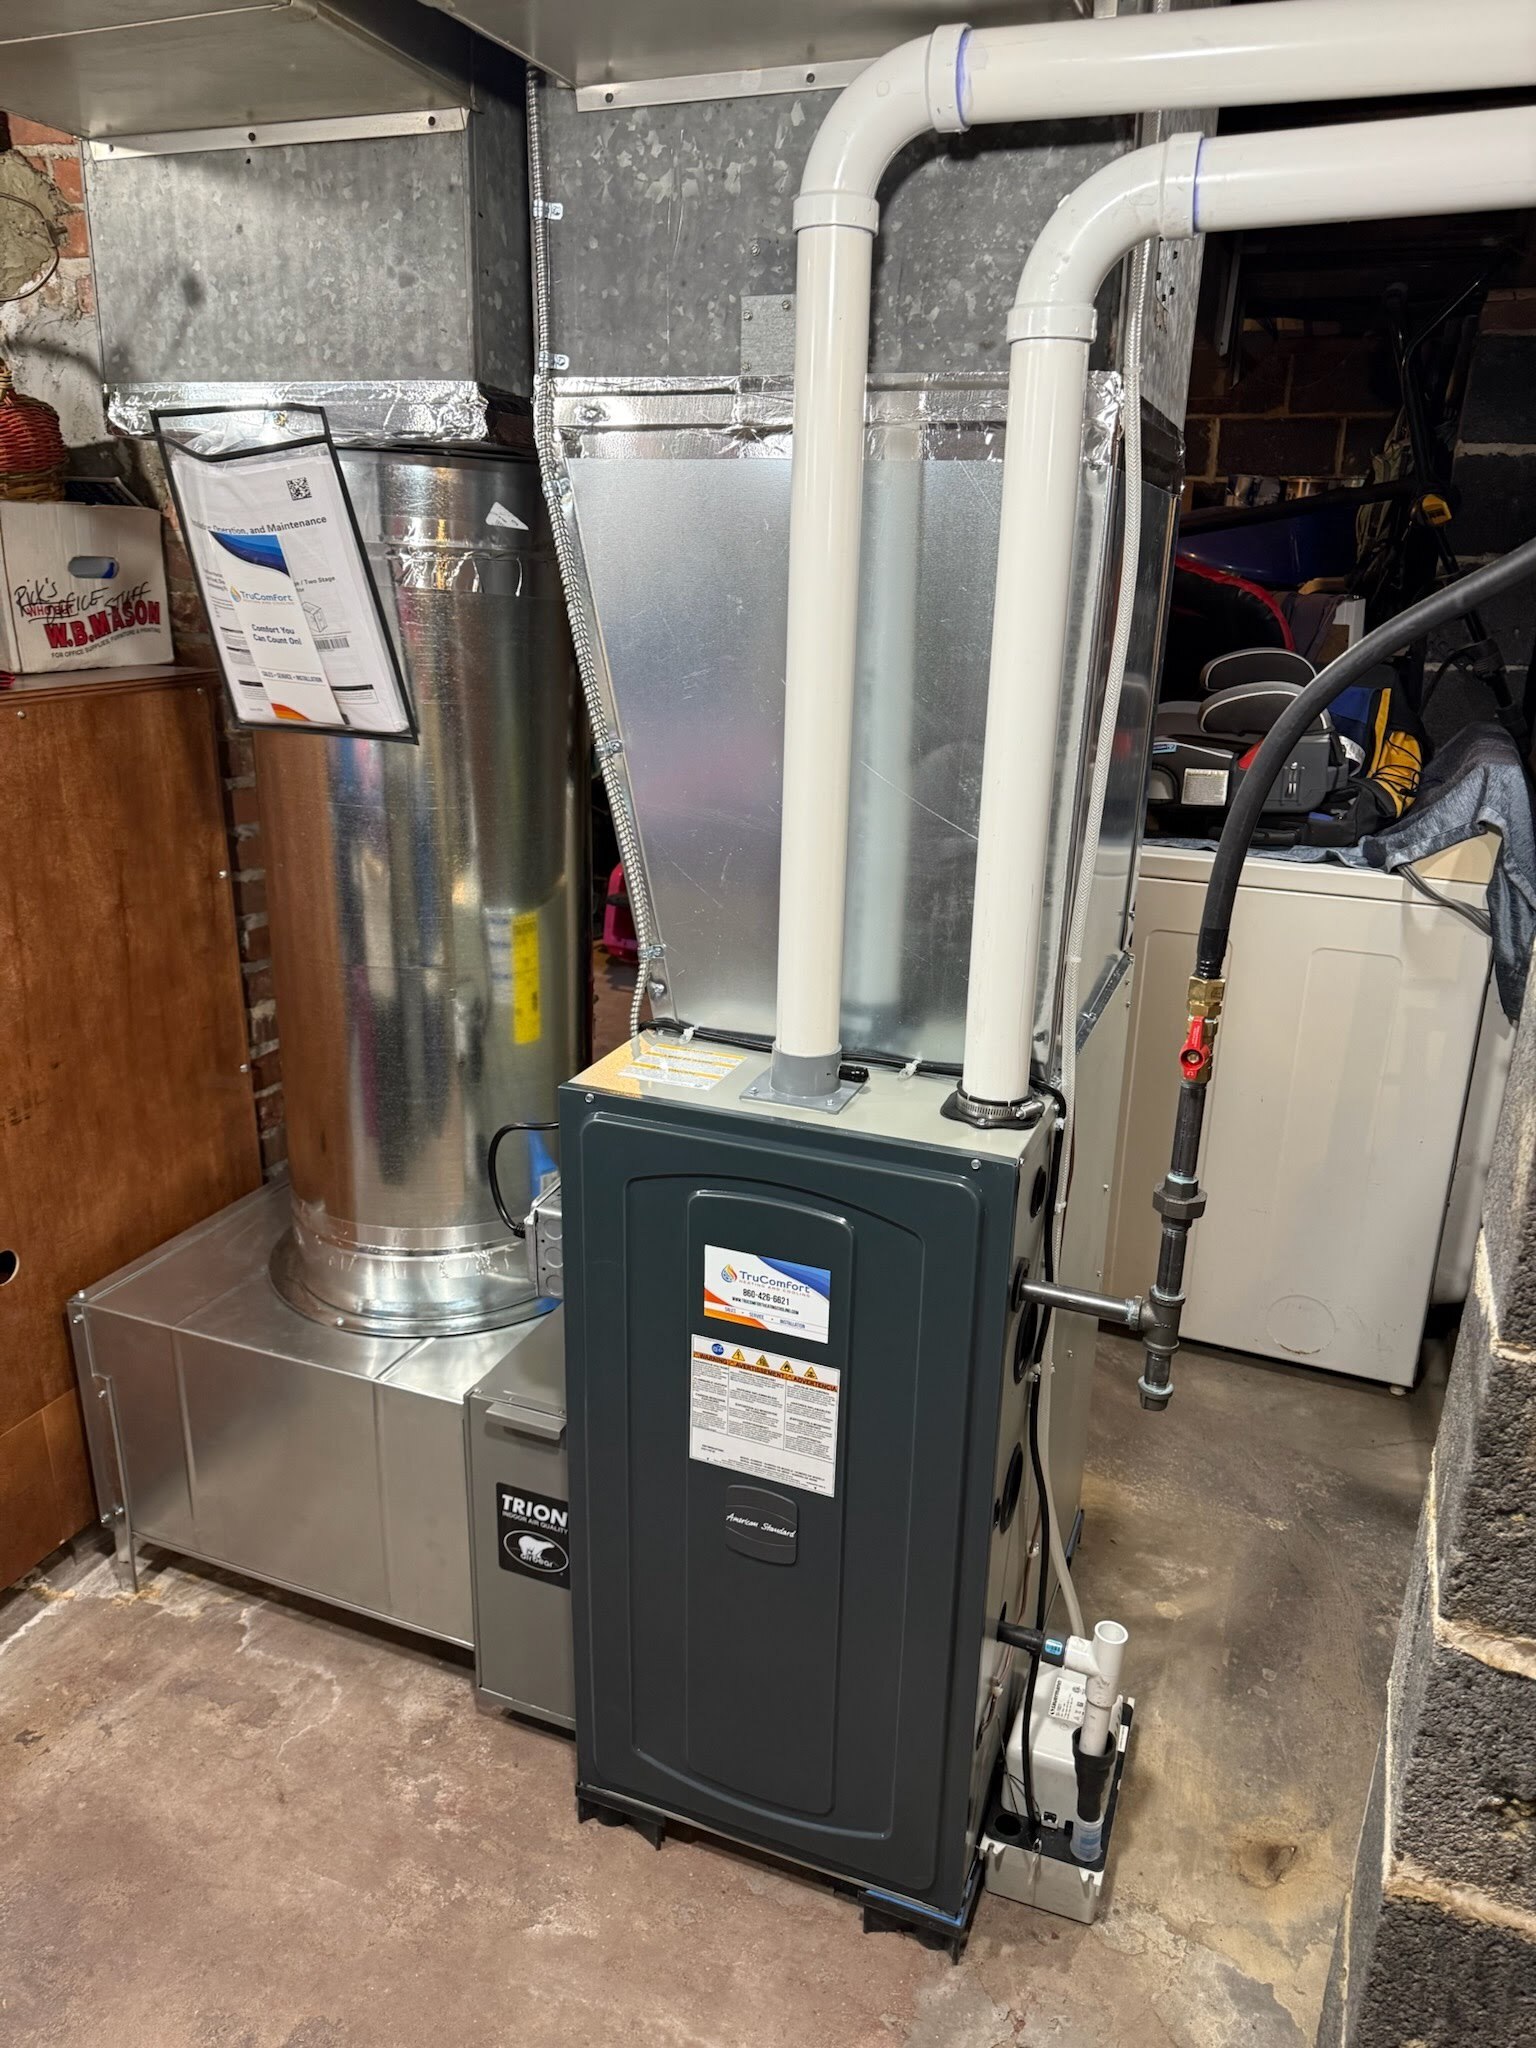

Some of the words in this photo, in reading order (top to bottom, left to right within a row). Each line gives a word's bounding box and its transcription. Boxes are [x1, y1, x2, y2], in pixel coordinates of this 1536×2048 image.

[249, 525, 266, 534] and
[266, 516, 327, 533] Maintenance
[251, 624, 281, 635] Comfort
[281, 626, 295, 635] You
[253, 633, 268, 643] Can
[268, 635, 289, 645] Count
[742, 1288, 790, 1306] 860-426-6621
[501, 1493, 569, 1528] TRION
[501, 1510, 528, 1522] INDOOR
[528, 1518, 540, 1528] AIR
[540, 1521, 569, 1535] QUALITY
[726, 1512, 759, 1528] American
[761, 1522, 797, 1538] Standard
